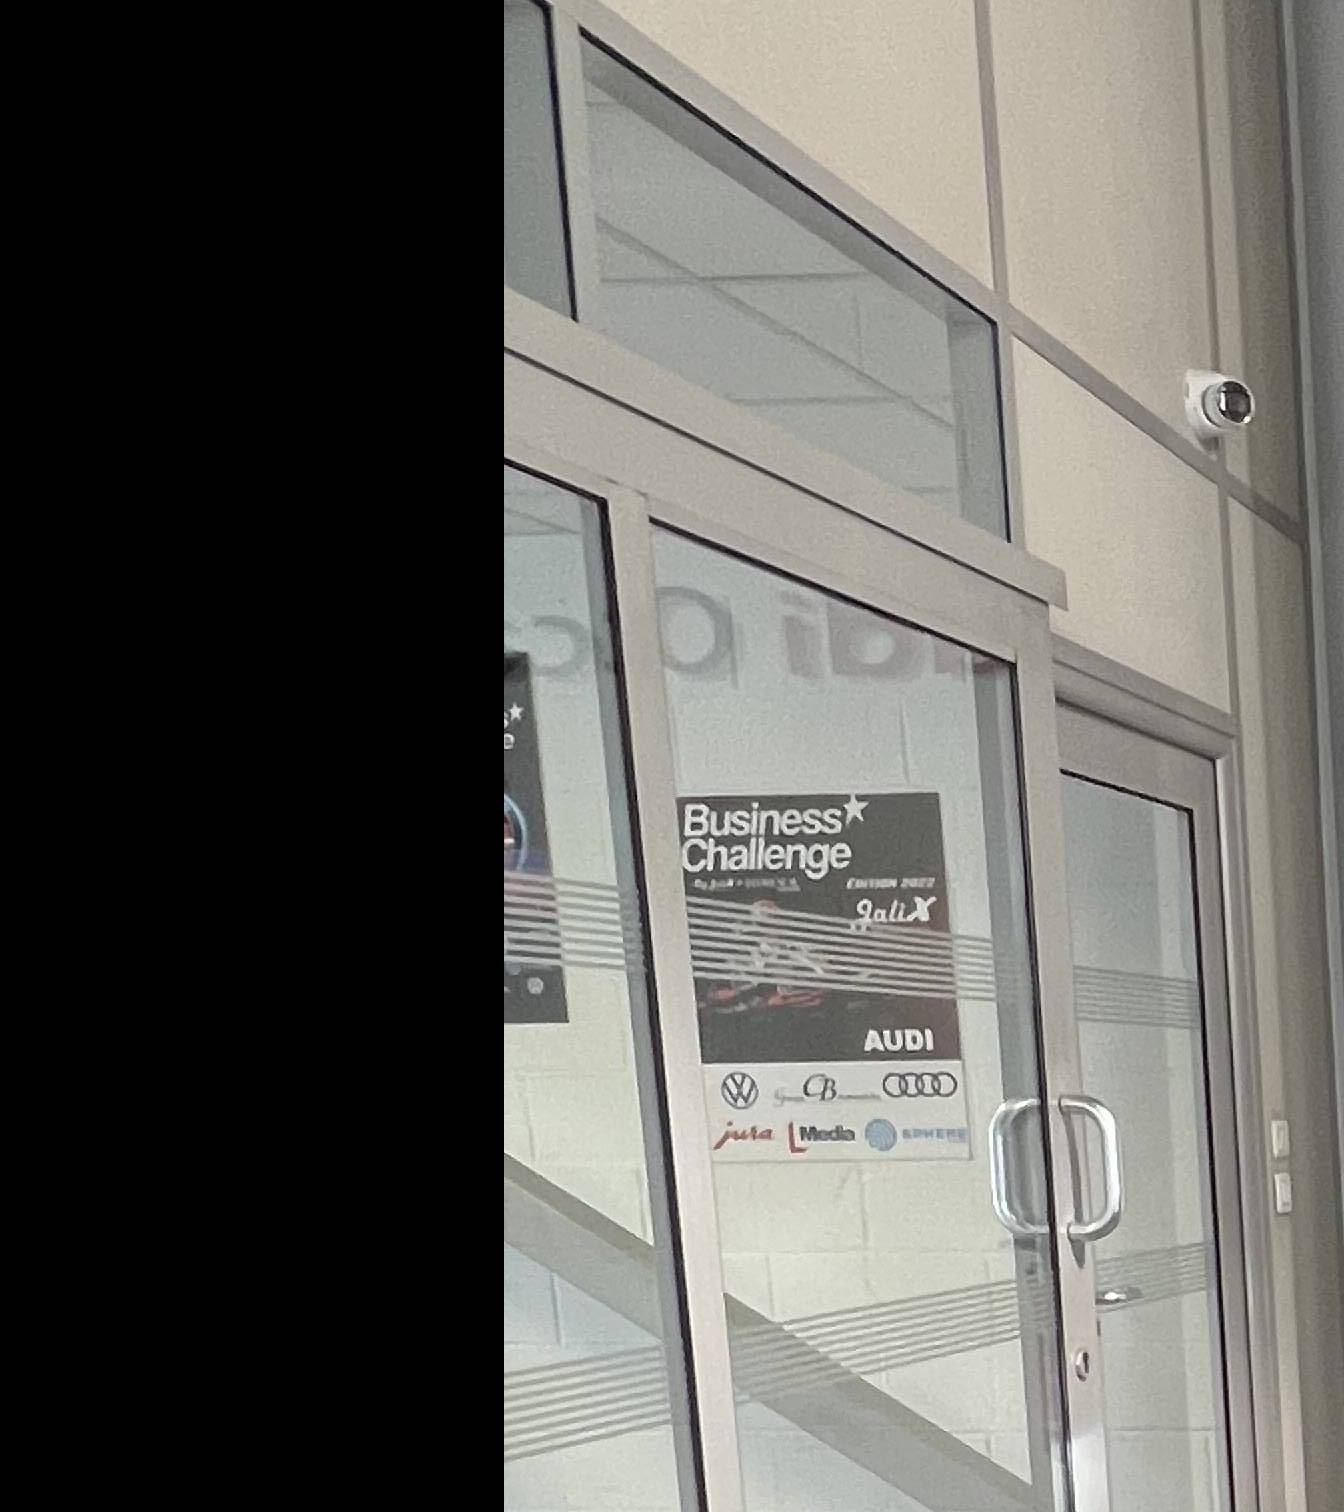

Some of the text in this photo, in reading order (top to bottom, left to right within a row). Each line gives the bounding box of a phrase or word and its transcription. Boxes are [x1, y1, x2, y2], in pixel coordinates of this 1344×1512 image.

[683, 802, 842, 837] Business
[682, 837, 852, 880] Challenge
[863, 1028, 935, 1052] AUDI
